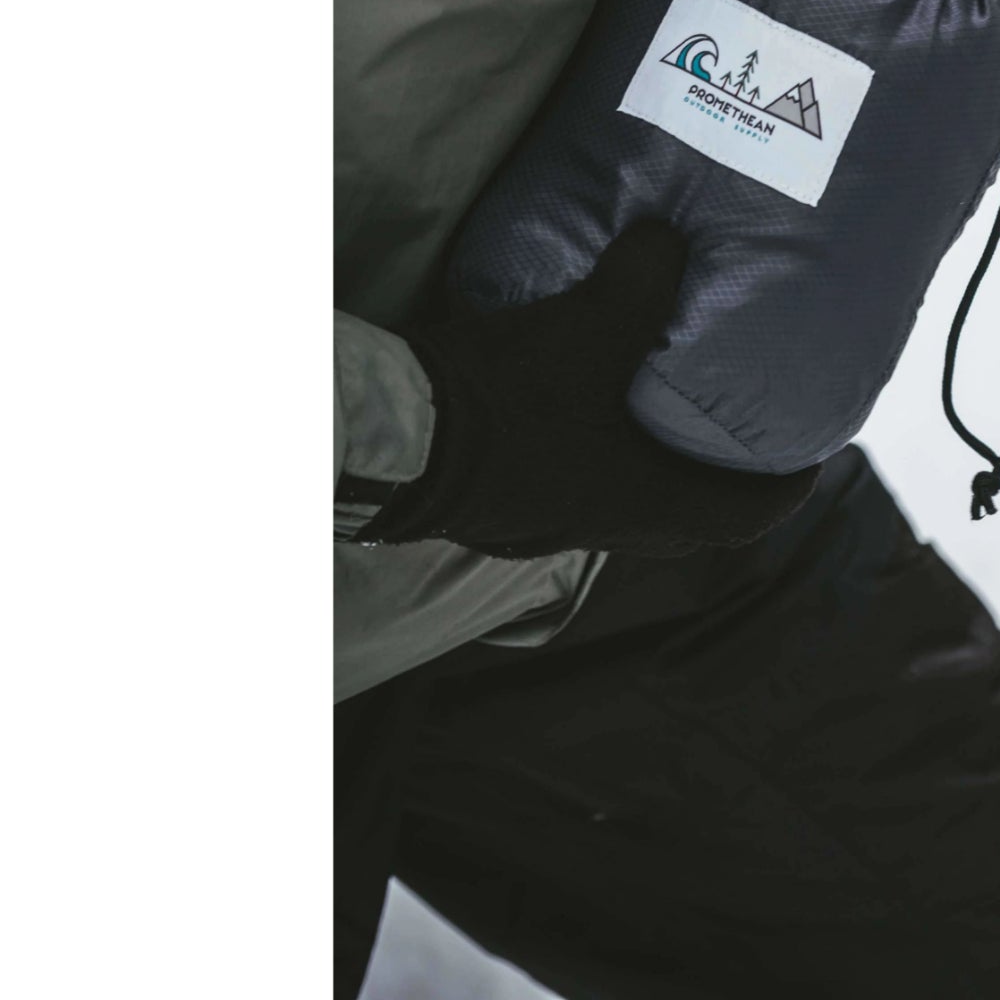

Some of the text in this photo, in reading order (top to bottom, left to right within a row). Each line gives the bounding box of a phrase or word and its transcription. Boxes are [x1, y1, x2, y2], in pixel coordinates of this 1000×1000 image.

[683, 96, 770, 144] OUTDOOR SUPPLY
[688, 84, 776, 136] PROMETHEAN
